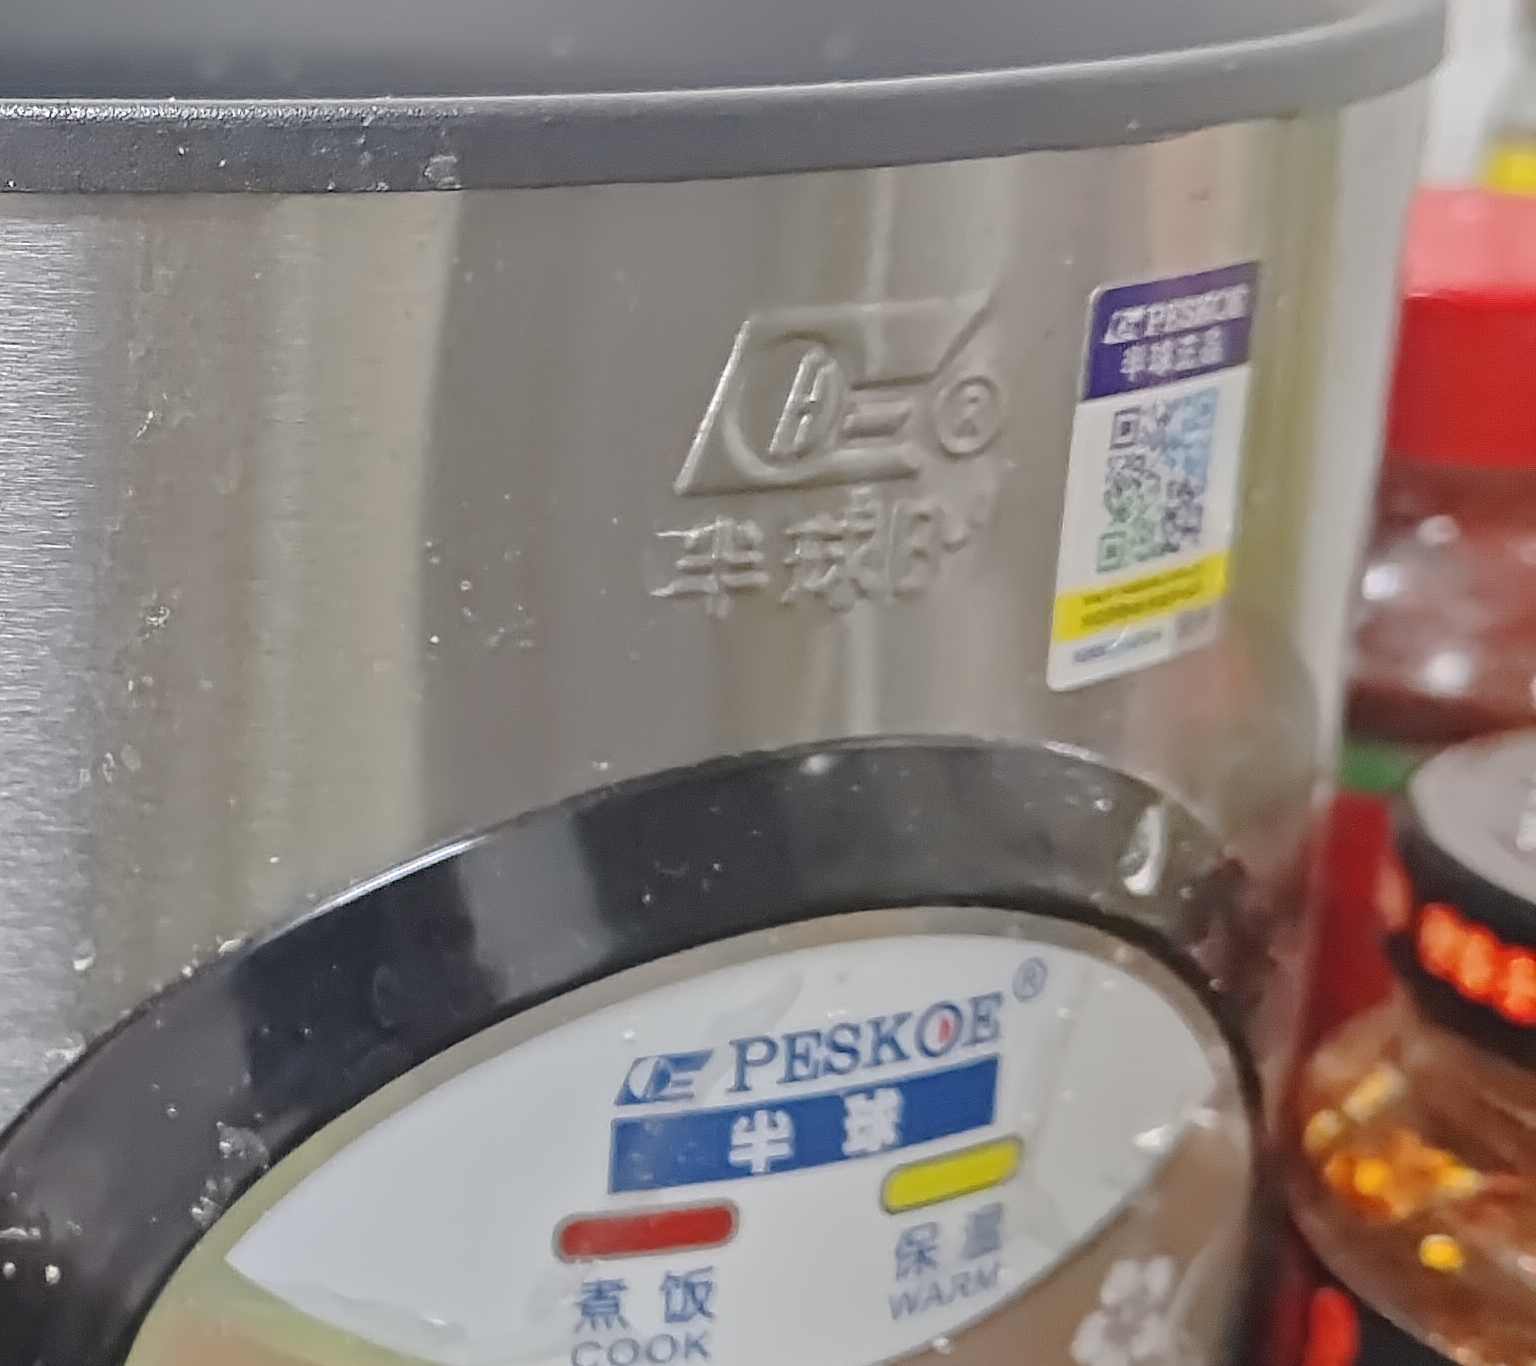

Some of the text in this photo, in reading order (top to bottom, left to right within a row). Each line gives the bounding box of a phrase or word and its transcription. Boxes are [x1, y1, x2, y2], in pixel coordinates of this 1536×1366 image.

[726, 991, 1004, 1094] PESKOE
[575, 1266, 716, 1332] 煮饭
[888, 1259, 1002, 1321] WARM
